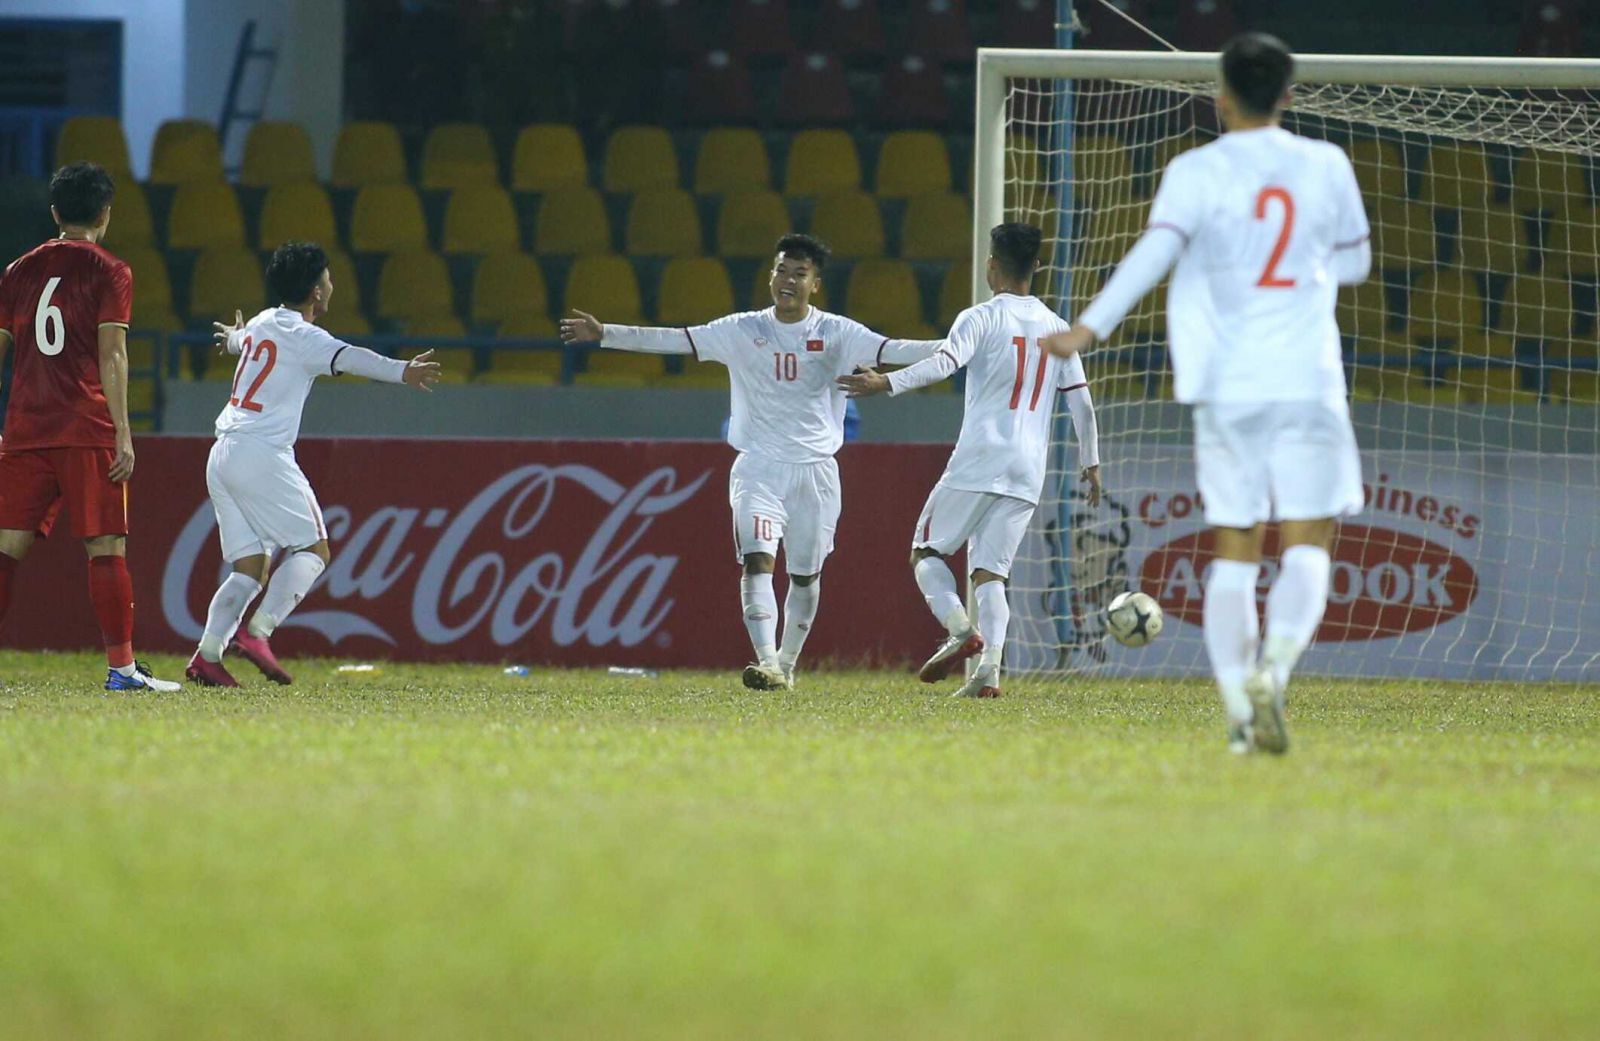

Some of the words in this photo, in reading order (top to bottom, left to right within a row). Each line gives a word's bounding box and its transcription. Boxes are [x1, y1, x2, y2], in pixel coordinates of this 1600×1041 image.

[1255, 186, 1295, 288] 2
[35, 276, 66, 357] 6
[231, 334, 278, 414] 22
[773, 351, 798, 382] 10
[1008, 335, 1049, 412] 11
[160, 463, 716, 647] Ca-Cola
[751, 514, 773, 542] 10
[1162, 556, 1455, 608] AOOK
